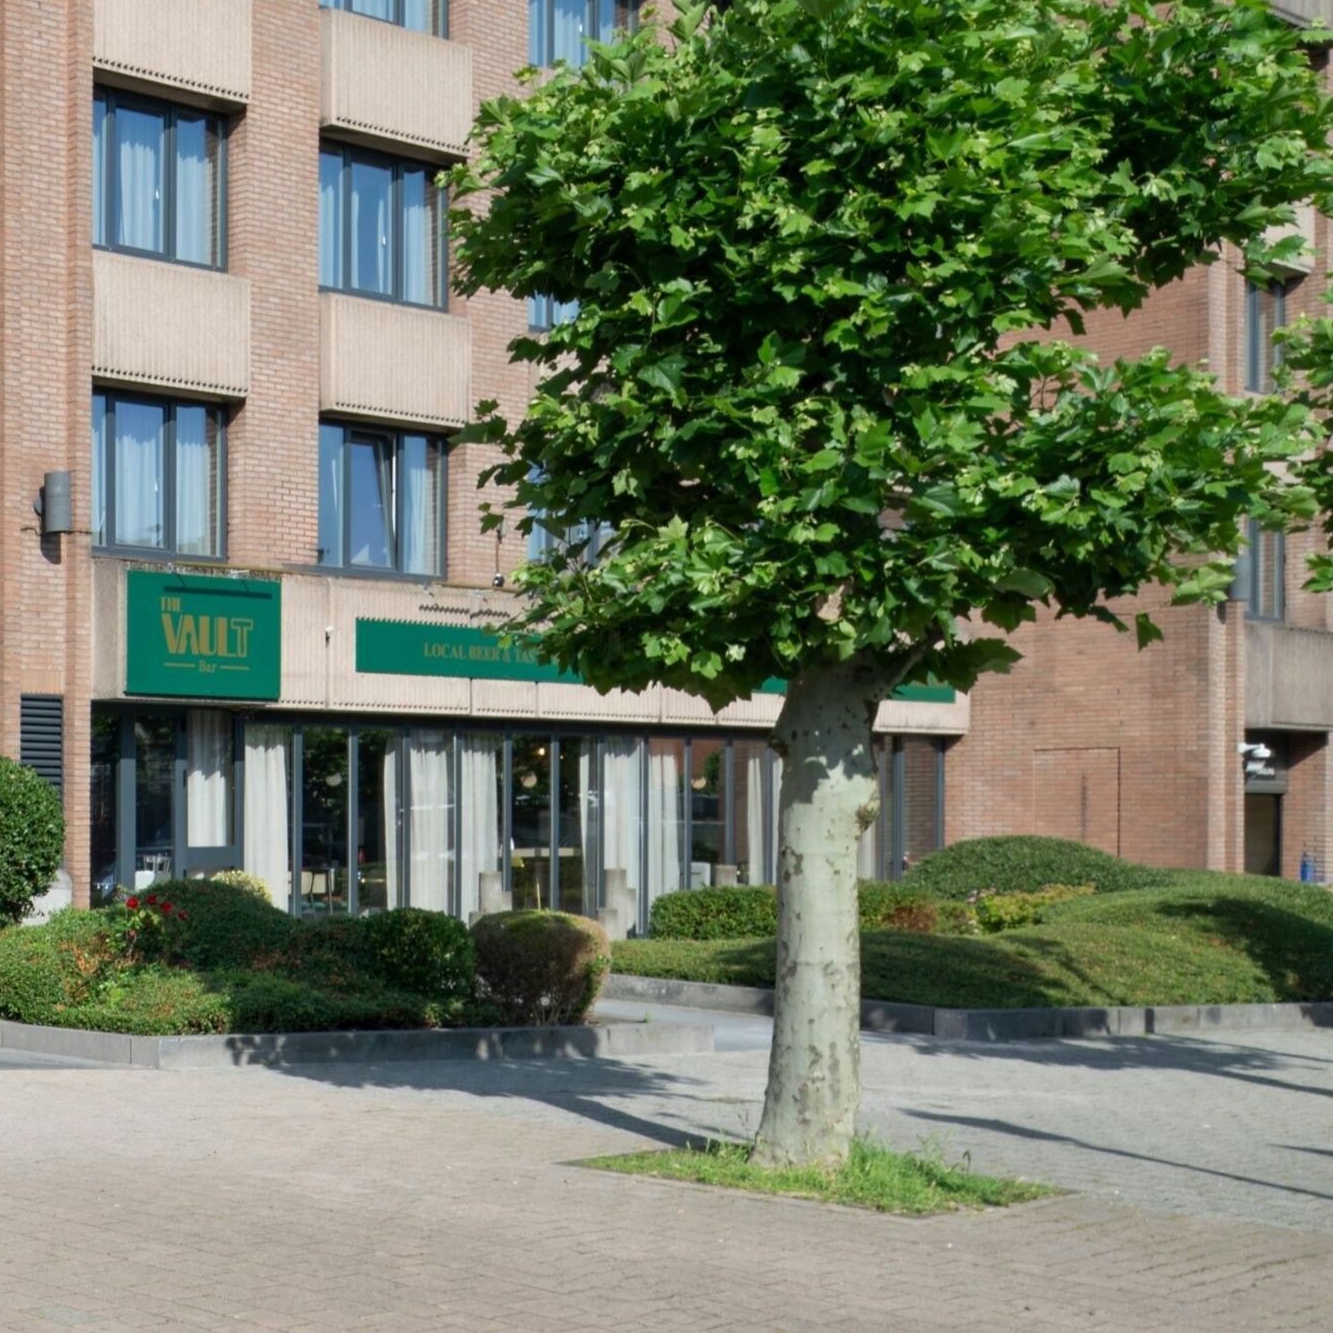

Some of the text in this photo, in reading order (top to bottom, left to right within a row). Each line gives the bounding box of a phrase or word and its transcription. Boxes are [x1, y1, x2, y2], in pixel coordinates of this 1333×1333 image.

[161, 596, 181, 612] THE
[161, 612, 253, 658] VAULT
[424, 642, 465, 660] LOCAL
[468, 645, 500, 662] BEER
